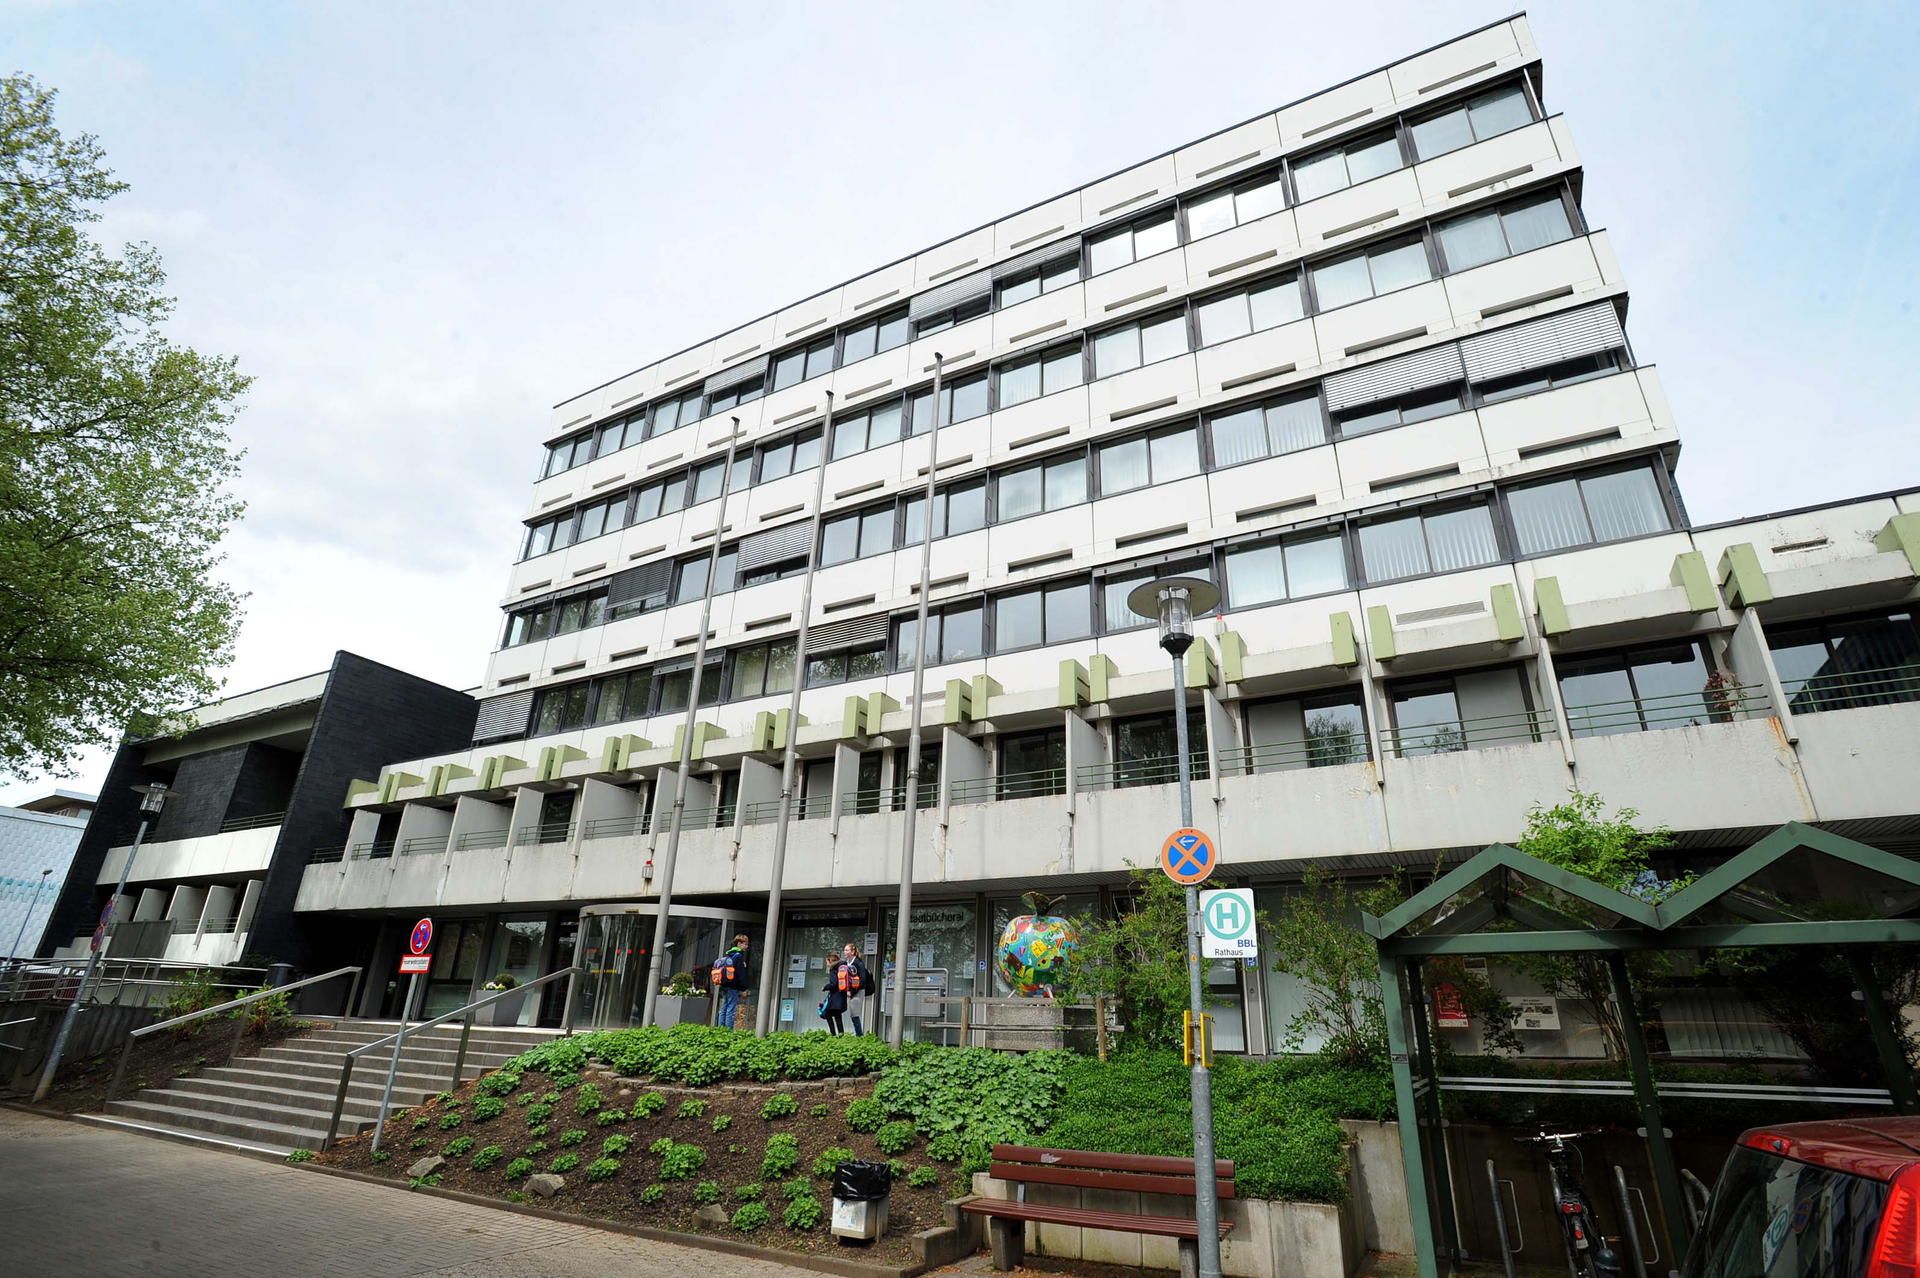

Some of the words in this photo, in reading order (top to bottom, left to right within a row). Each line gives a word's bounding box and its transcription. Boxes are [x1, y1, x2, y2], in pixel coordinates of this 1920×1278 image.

[910, 911, 964, 923] tadtbücherei
[1216, 903, 1239, 929] H
[1237, 940, 1256, 948] BBL
[1214, 948, 1244, 956] Rathaus
